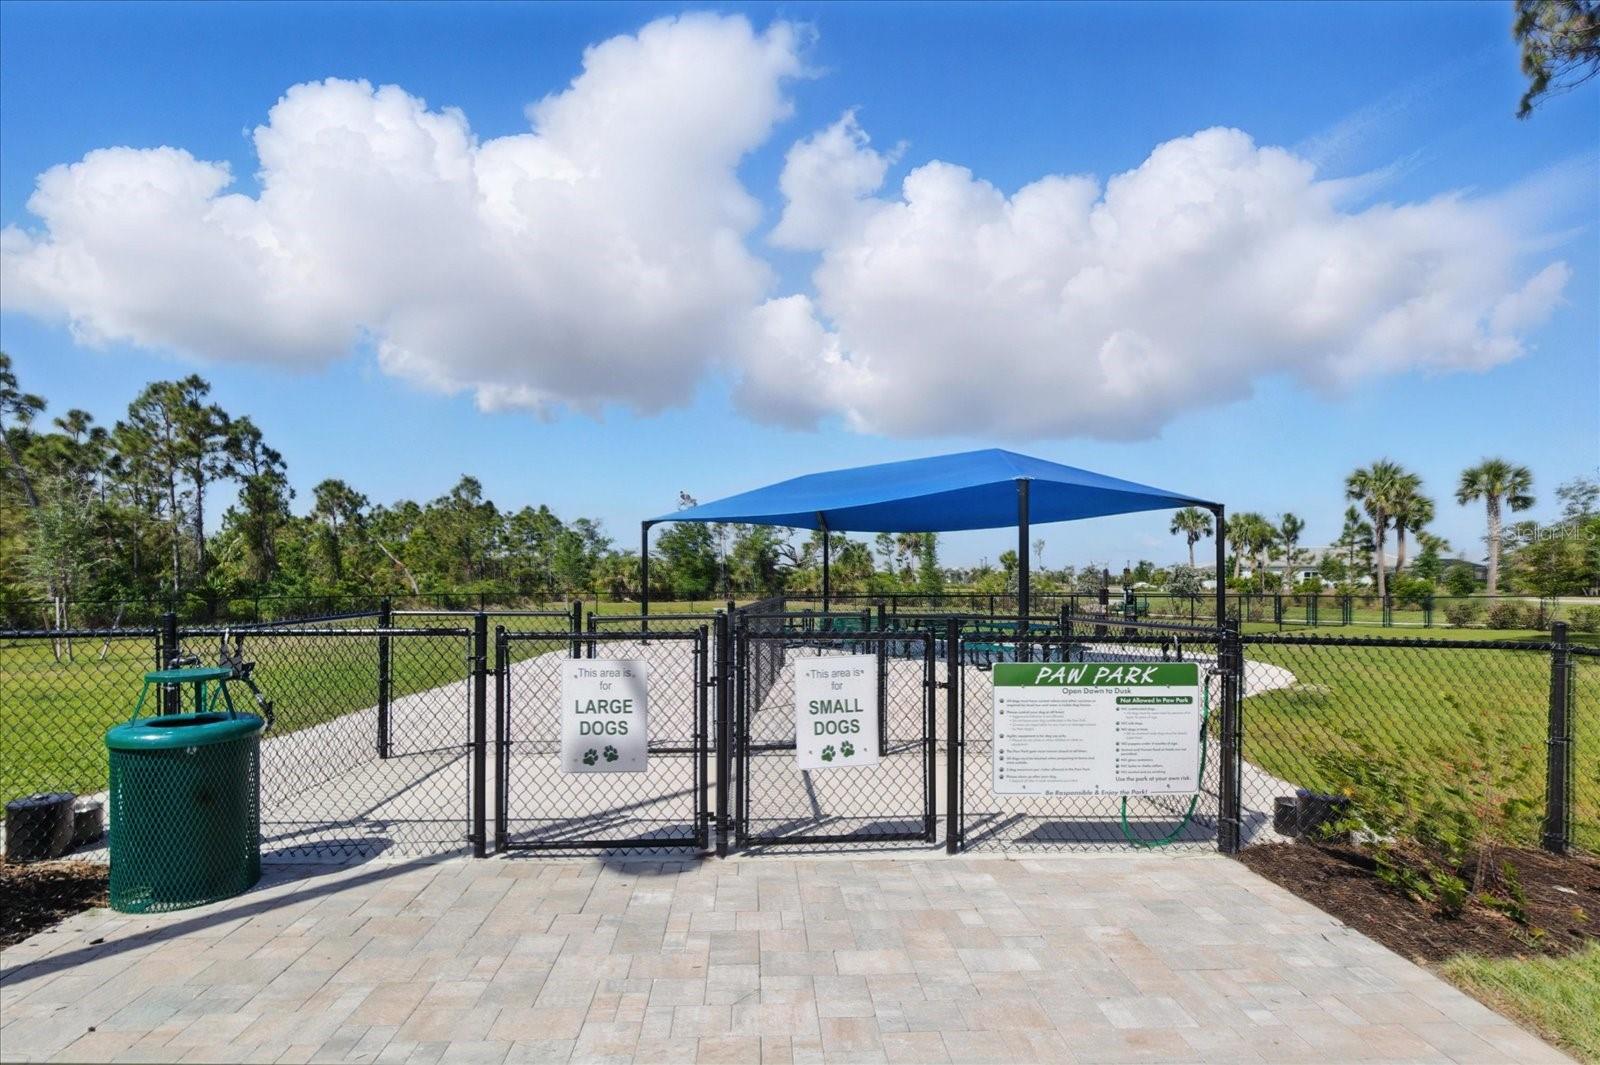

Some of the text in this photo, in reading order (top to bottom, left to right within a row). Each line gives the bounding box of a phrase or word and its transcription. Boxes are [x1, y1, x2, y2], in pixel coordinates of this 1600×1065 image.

[578, 667, 632, 678] This area is
[810, 668, 861, 679] This area is
[1035, 664, 1159, 685] PAW PARK
[599, 681, 612, 691] for
[831, 681, 843, 691] for
[1062, 687, 1082, 695] Open
[1132, 696, 1155, 704] Allowed
[575, 699, 633, 714] LARGE
[809, 698, 864, 715] SMALL
[580, 720, 628, 736] DOGS
[814, 719, 860, 735] DOGS
[1055, 789, 1093, 797] Responsible
